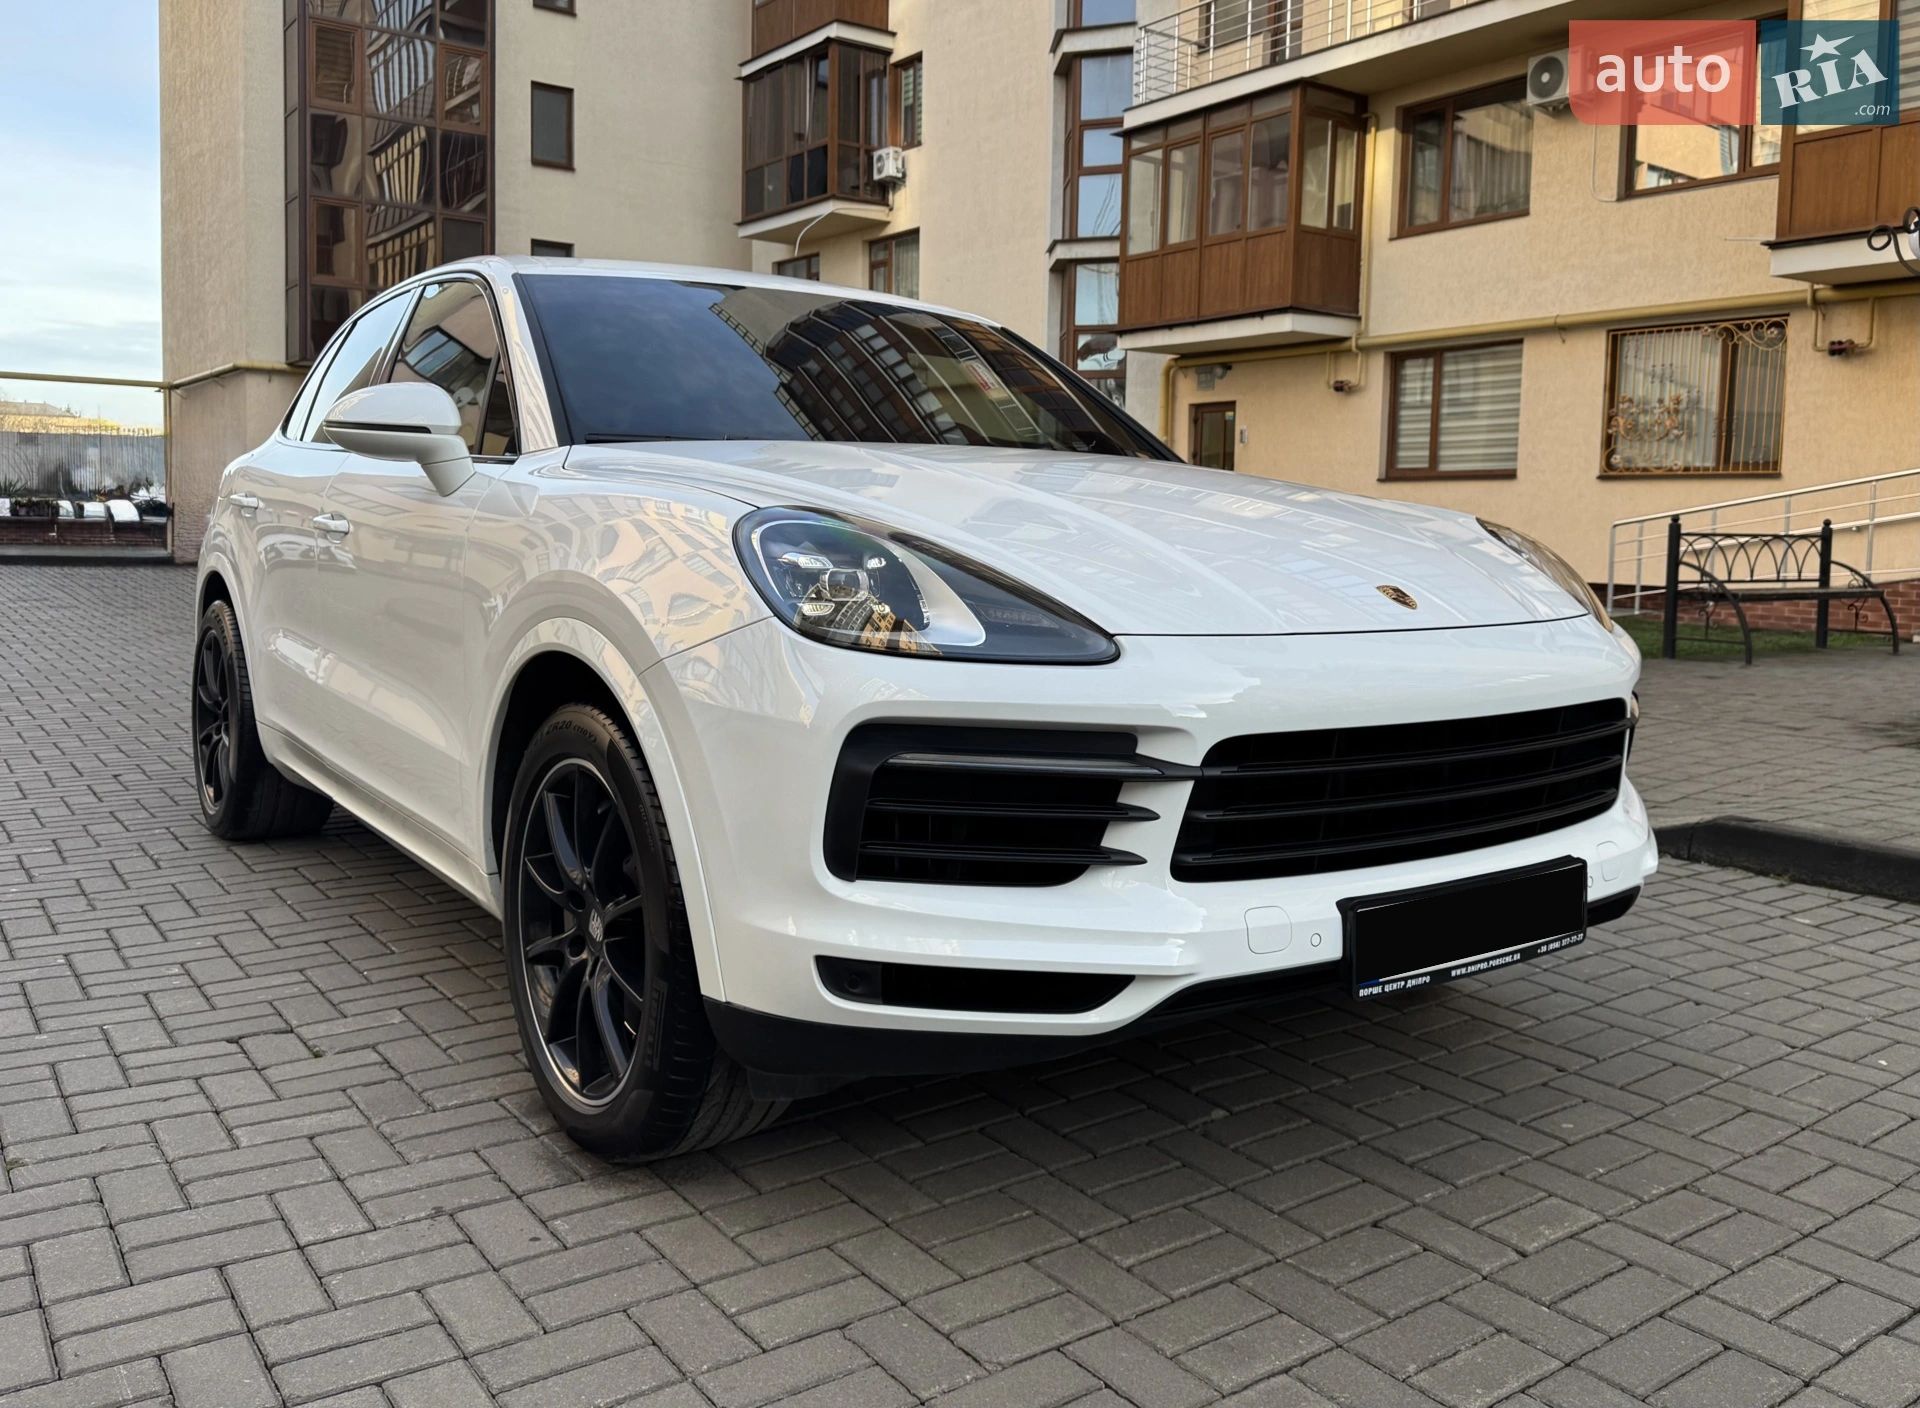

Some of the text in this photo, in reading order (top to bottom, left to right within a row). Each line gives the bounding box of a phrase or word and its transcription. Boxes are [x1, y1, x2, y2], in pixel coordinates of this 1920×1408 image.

[545, 720, 573, 736] ZR20
[1450, 952, 1521, 977] WWW.DNIPRO.PORSCHE.UA
[1359, 975, 1431, 997] ПОРШЕ ЦЕНТР ДНІПРО
